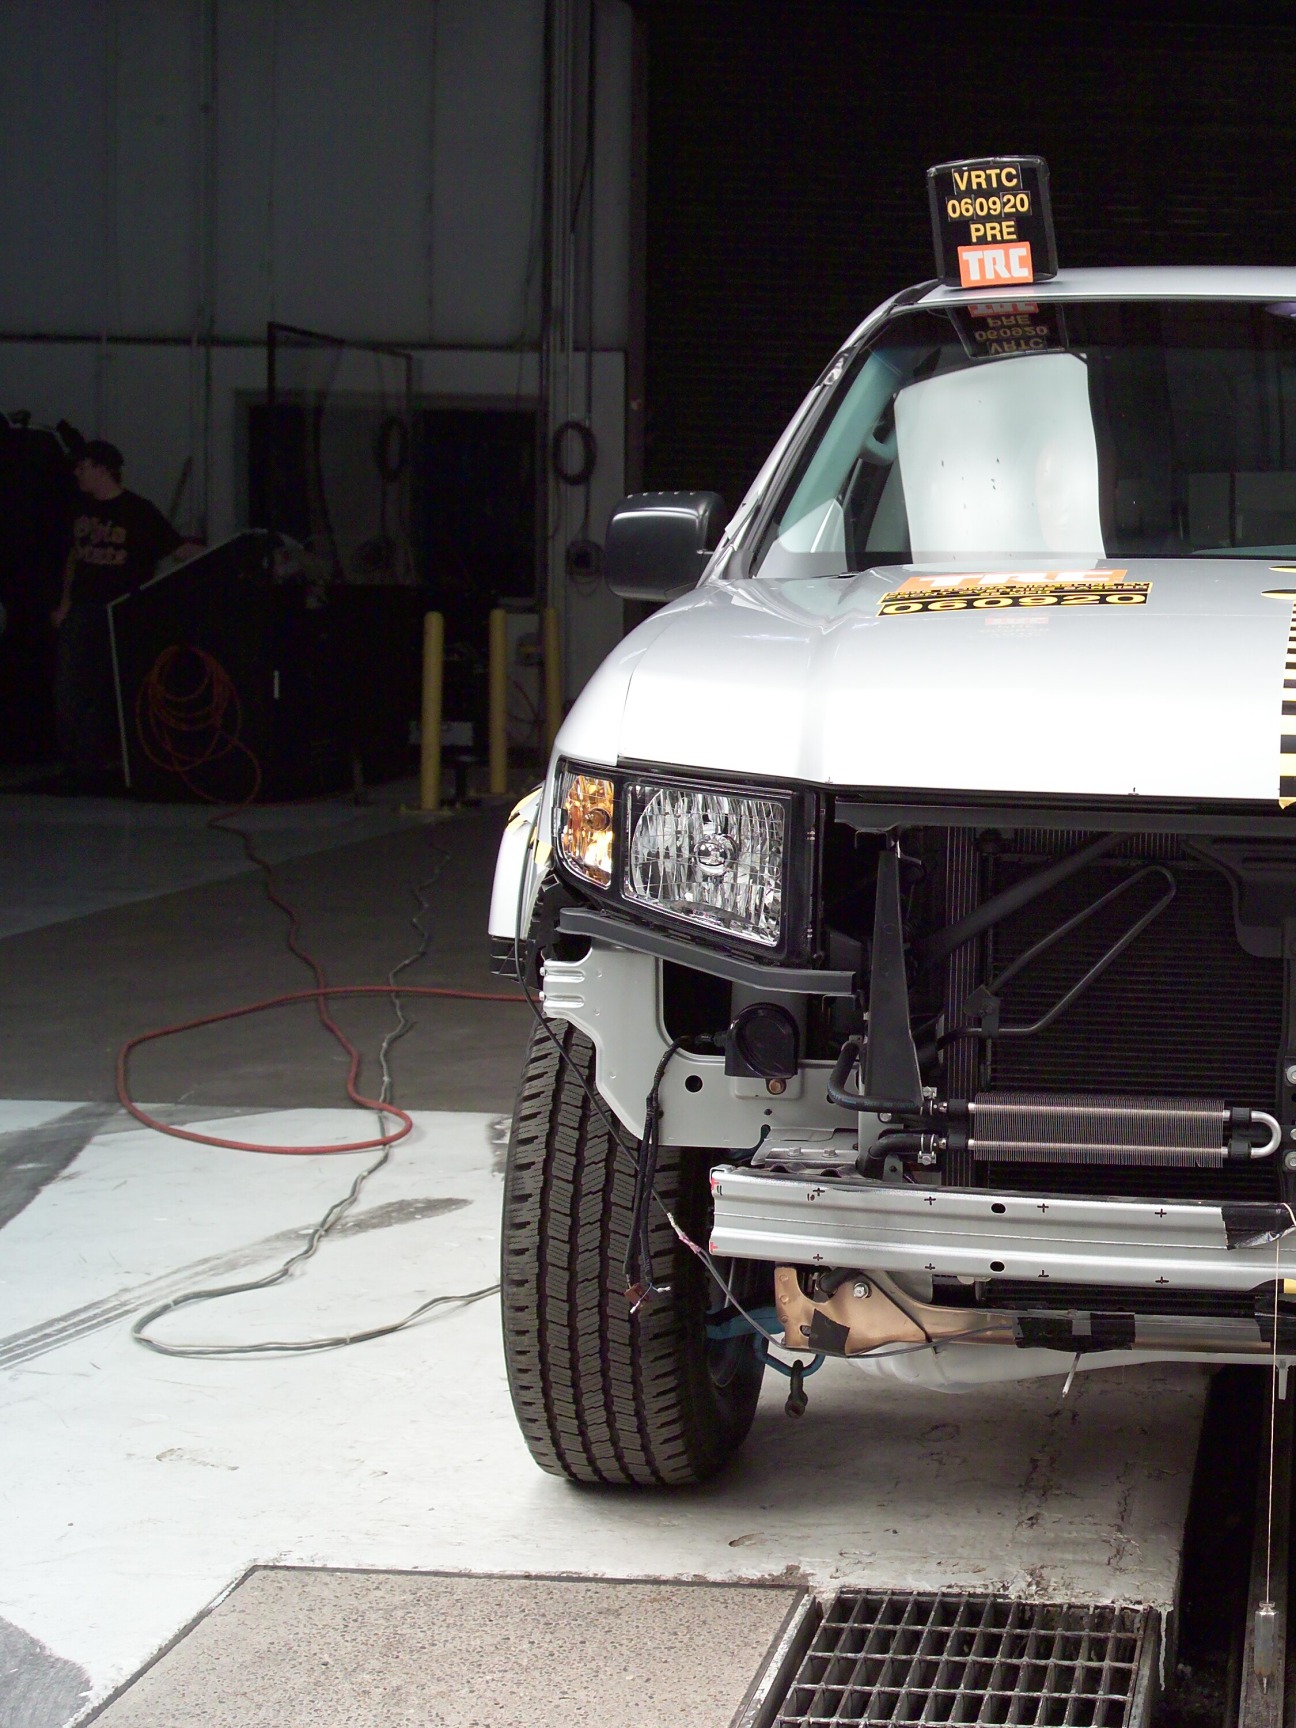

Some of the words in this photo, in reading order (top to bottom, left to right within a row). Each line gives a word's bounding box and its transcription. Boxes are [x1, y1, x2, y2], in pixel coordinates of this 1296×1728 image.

[953, 167, 1018, 191] VRTC
[947, 193, 1029, 218] 060920
[970, 221, 1018, 243] PRE
[962, 247, 1030, 281] TRC
[919, 571, 1113, 587] TRC
[882, 593, 1147, 615] 060920
